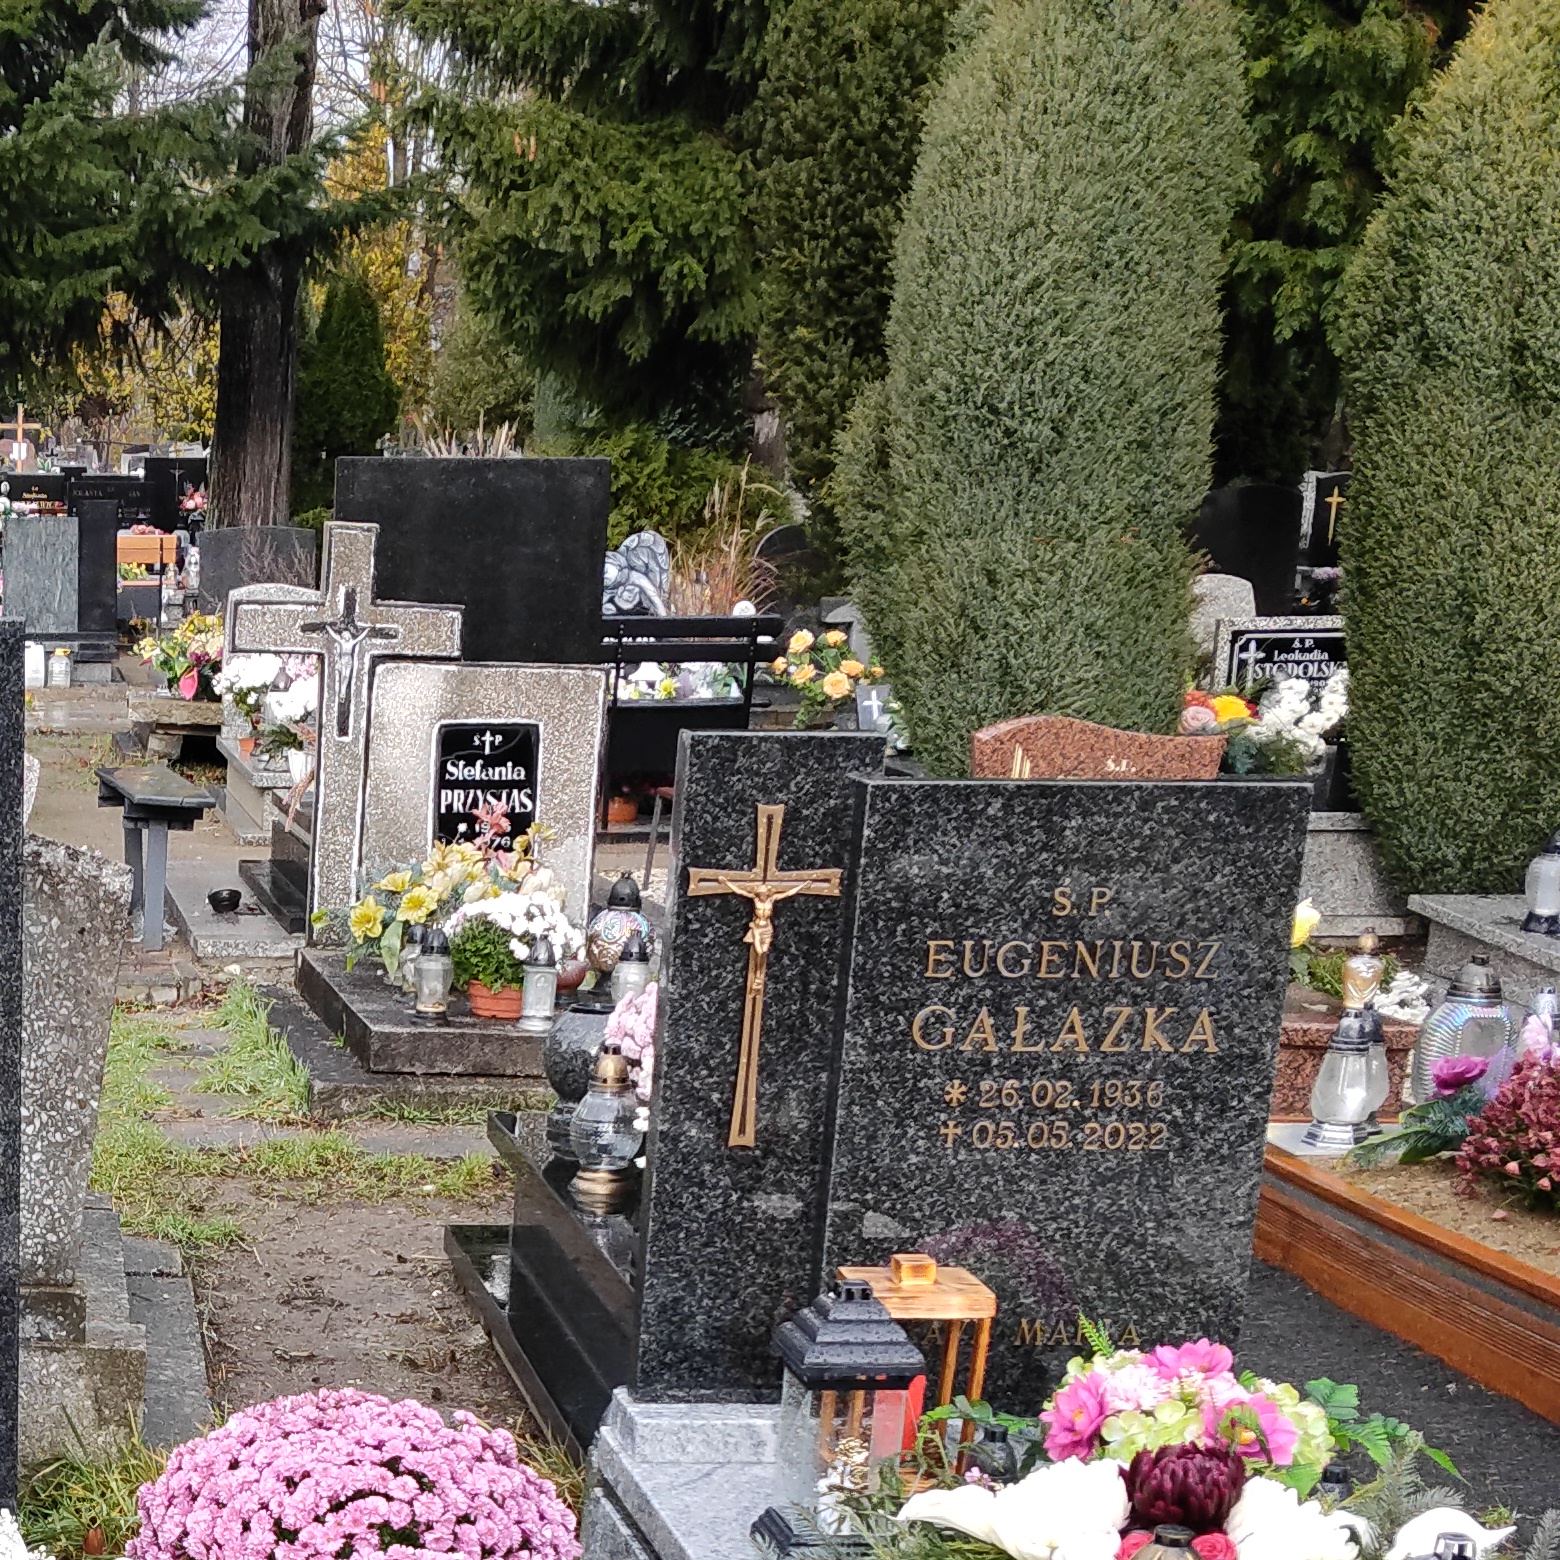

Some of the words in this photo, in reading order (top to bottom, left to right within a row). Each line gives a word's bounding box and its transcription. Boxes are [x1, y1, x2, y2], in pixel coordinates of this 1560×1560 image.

[1254, 660, 1347, 679] STODOLSK
[1273, 649, 1329, 661] Leokadia
[444, 759, 527, 781] Stefania
[924, 939, 1225, 980] EUGENIUSZ
[911, 1004, 1220, 1062] GAŁĄZKA
[977, 1079, 1165, 1109] 26.02.1936
[971, 1119, 1168, 1151] 05.05.2022
